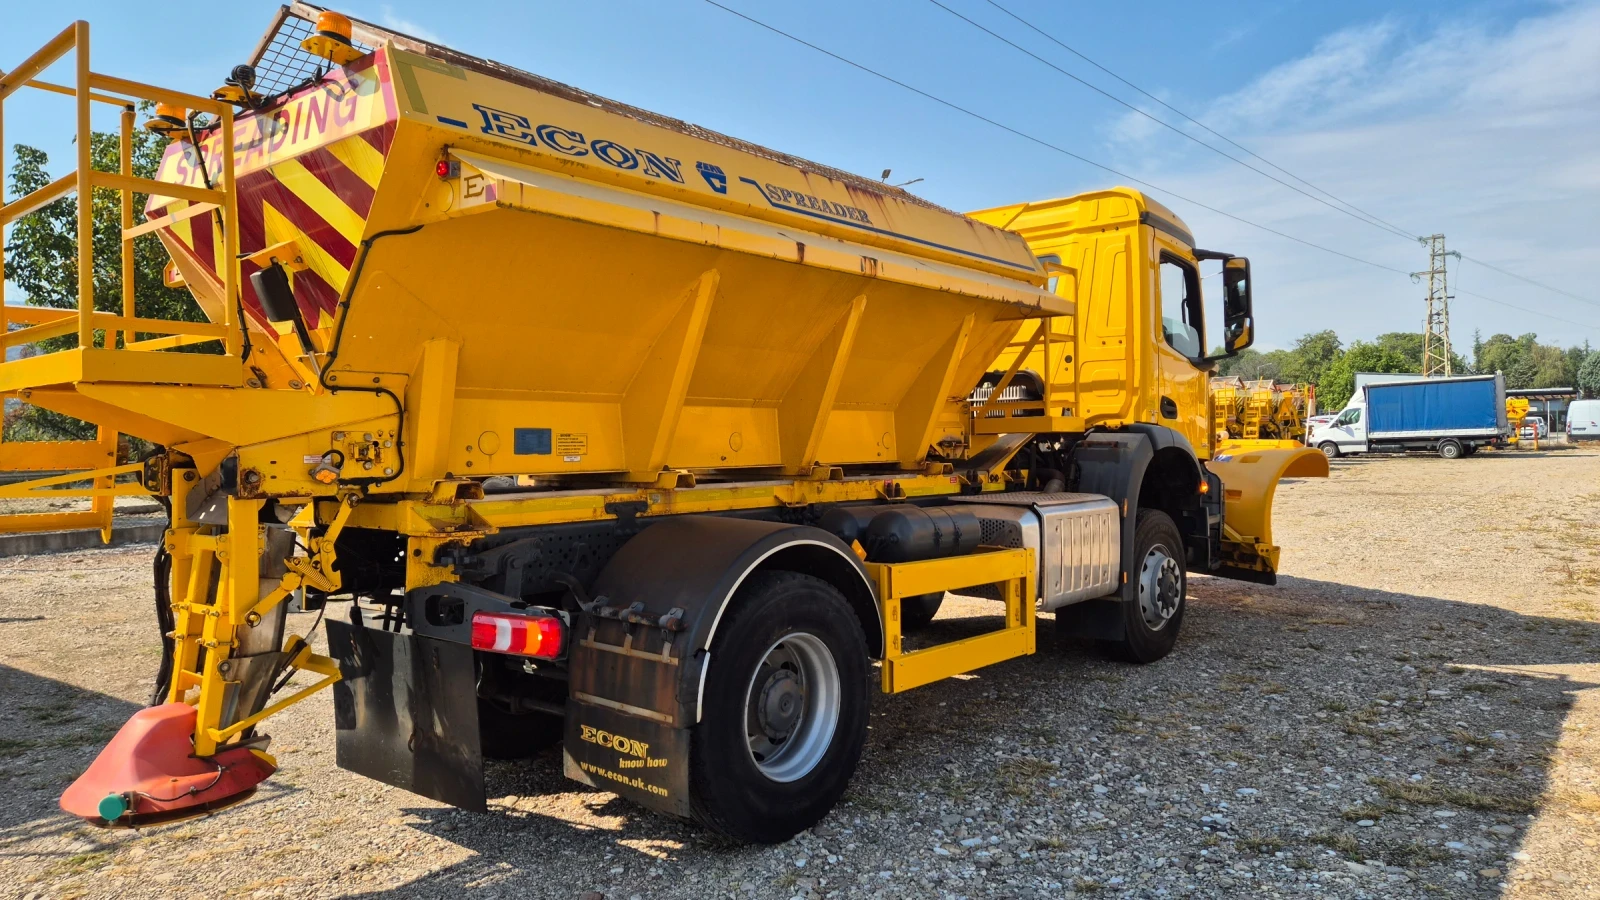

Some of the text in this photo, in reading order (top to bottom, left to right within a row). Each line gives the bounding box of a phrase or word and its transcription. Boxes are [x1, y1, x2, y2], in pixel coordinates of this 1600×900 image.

[472, 103, 684, 183] ECON
[464, 174, 485, 198] E
[765, 183, 872, 224] SPREADER
[581, 725, 648, 758] ECON
[581, 762, 668, 797] www.econ.uk.com
[619, 757, 667, 768] know how
